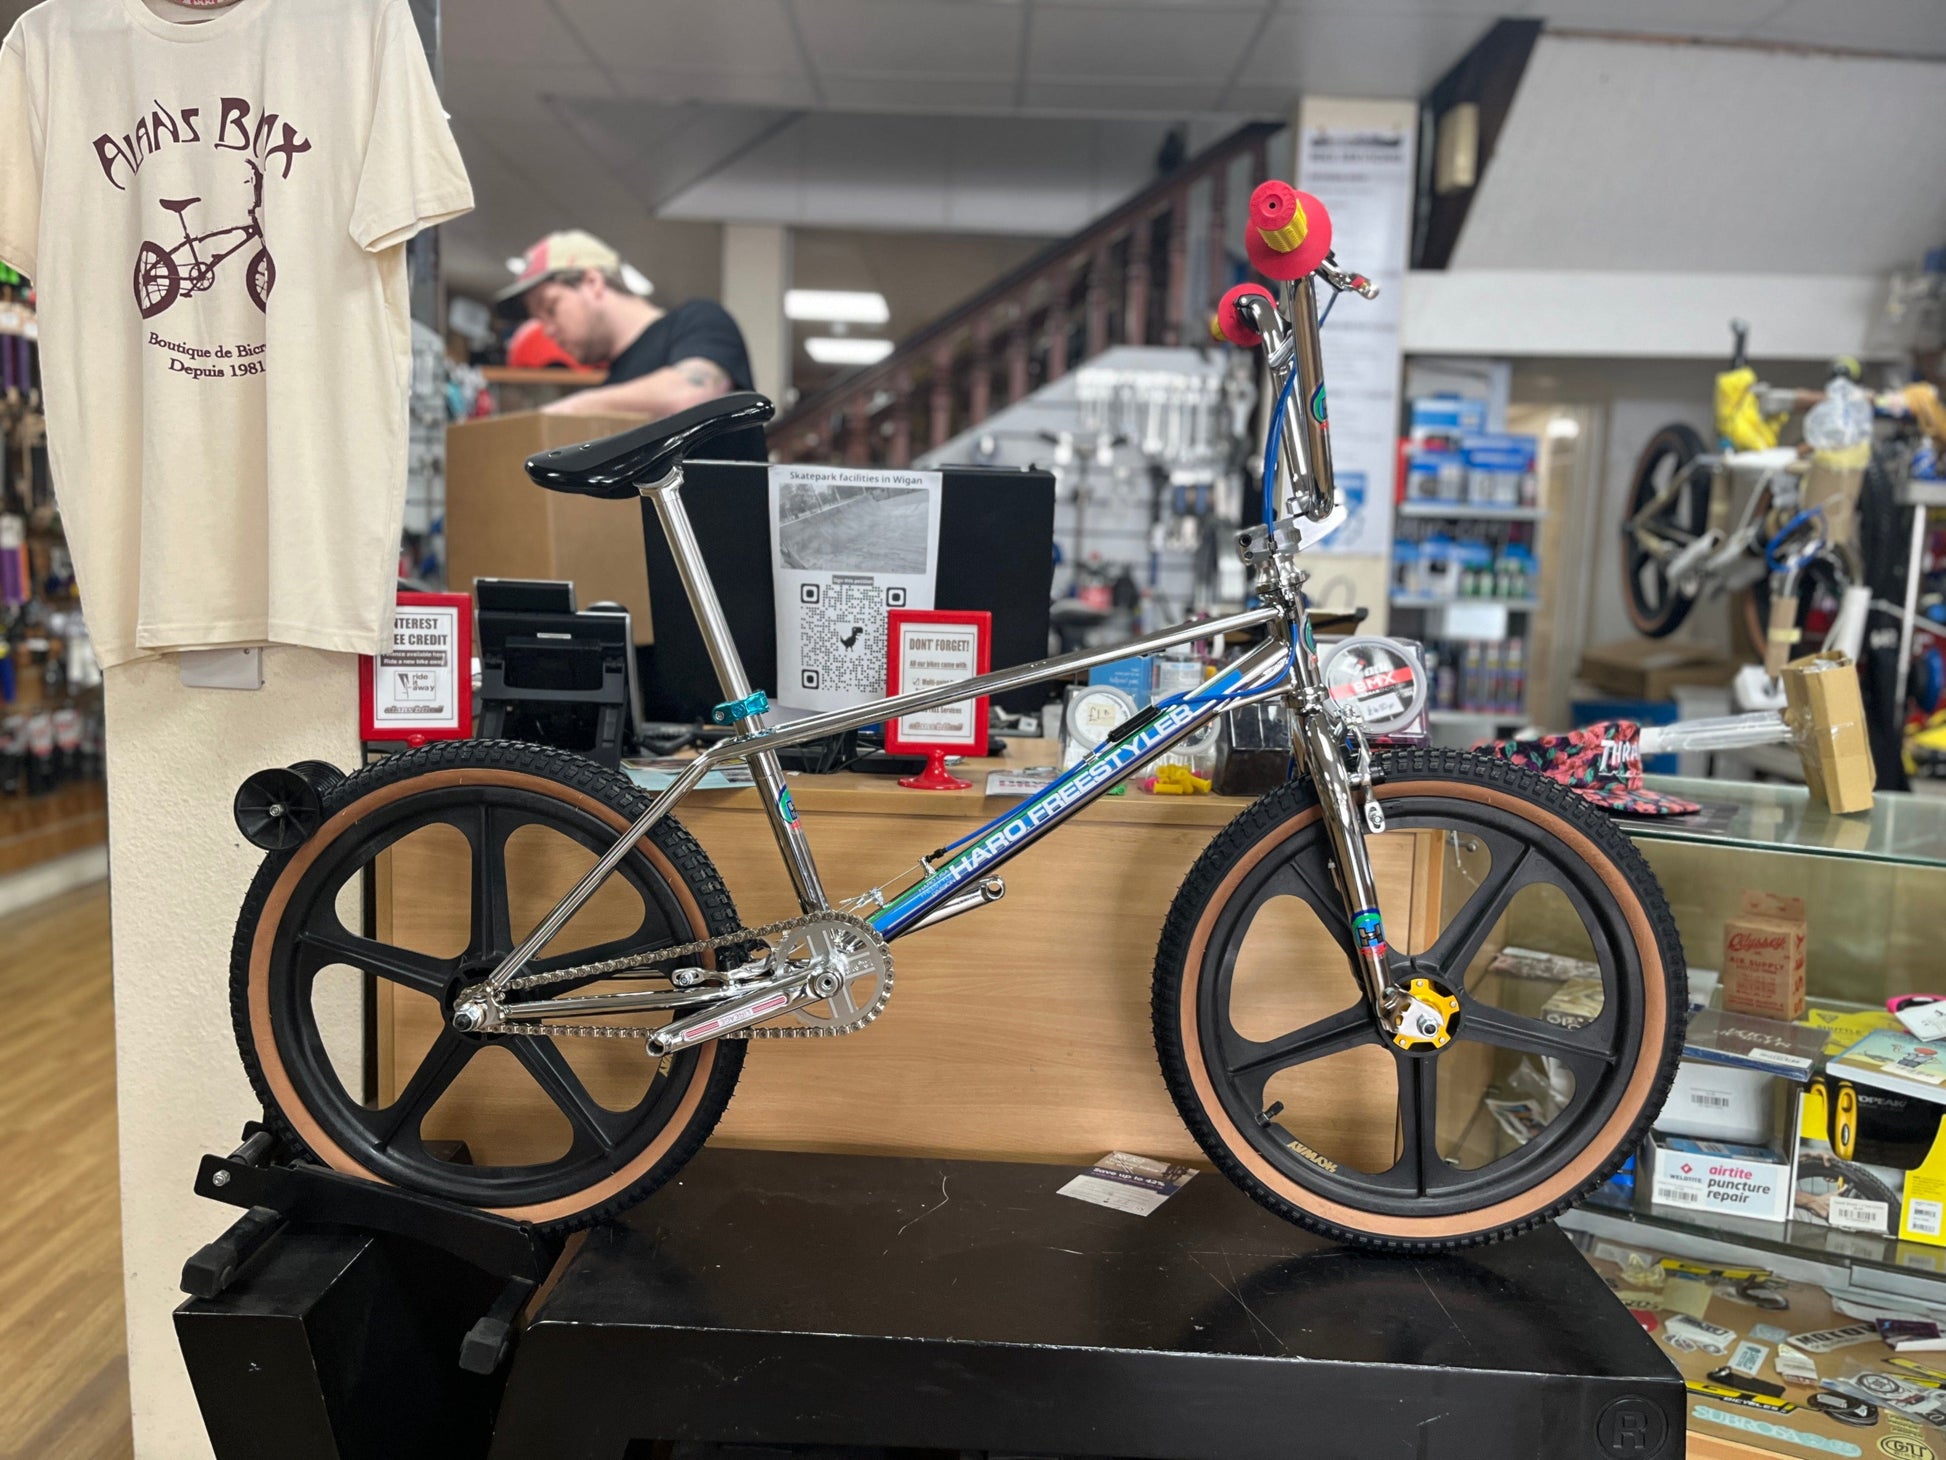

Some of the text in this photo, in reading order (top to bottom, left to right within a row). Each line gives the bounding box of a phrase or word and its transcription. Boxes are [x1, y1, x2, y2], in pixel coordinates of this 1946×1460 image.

[148, 332, 211, 360] Boutique
[215, 345, 233, 358] de
[168, 358, 266, 379] Depuis 1981
[790, 471, 923, 486] Skatepark facilities in Wigan
[408, 634, 448, 646] CREDIT
[935, 639, 970, 652] FORGET!
[1352, 671, 1397, 693] BMX
[949, 703, 1194, 881] HARO FREESTYLER
[1728, 933, 1786, 952] Odyssey
[1749, 960, 1784, 971] SUPPLY
[1286, 1140, 1339, 1174] SKYWAY
[1092, 1167, 1118, 1176] Save
[1133, 1174, 1144, 1182] to
[1669, 1173, 1703, 1184] WELDTITE
[1709, 1165, 1753, 1180] airtite
[1707, 1178, 1771, 1195] puncture
[1707, 1189, 1750, 1203] repair
[1692, 1405, 1802, 1444] SUBROSA
